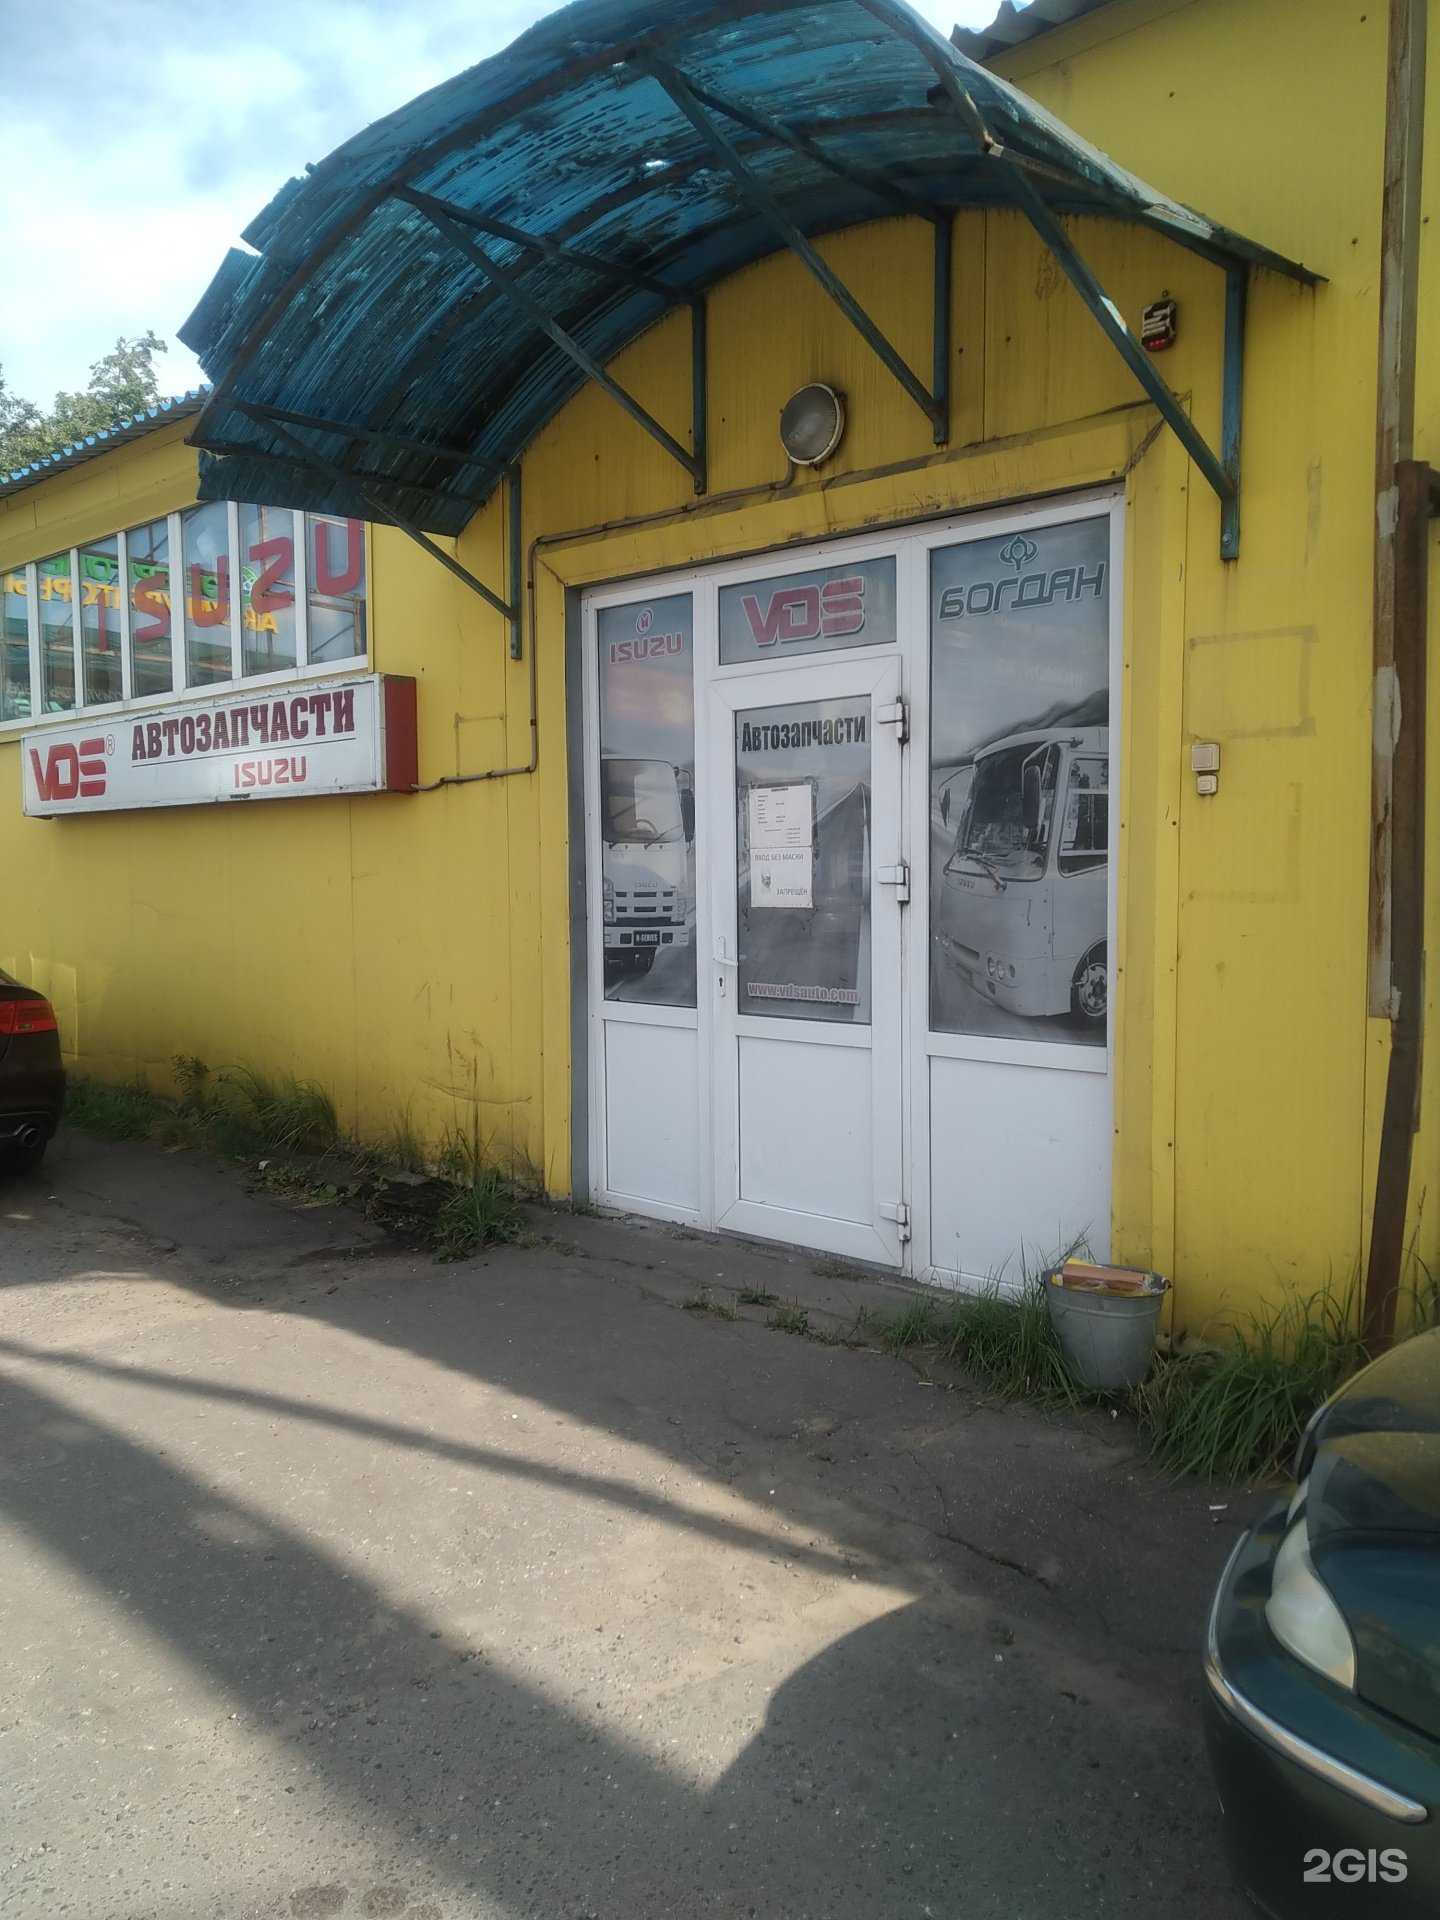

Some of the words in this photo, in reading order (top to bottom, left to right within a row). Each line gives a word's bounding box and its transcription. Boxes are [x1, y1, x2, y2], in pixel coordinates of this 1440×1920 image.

[98, 517, 362, 651] ISUZU
[741, 576, 865, 647] VDS
[937, 563, 1105, 621] БОГДАН
[609, 632, 684, 664] ISUZU
[131, 689, 355, 761] АВТОЗАПЧАСТИ
[741, 715, 866, 753] Автозапчасти
[233, 756, 307, 788] ISUZU
